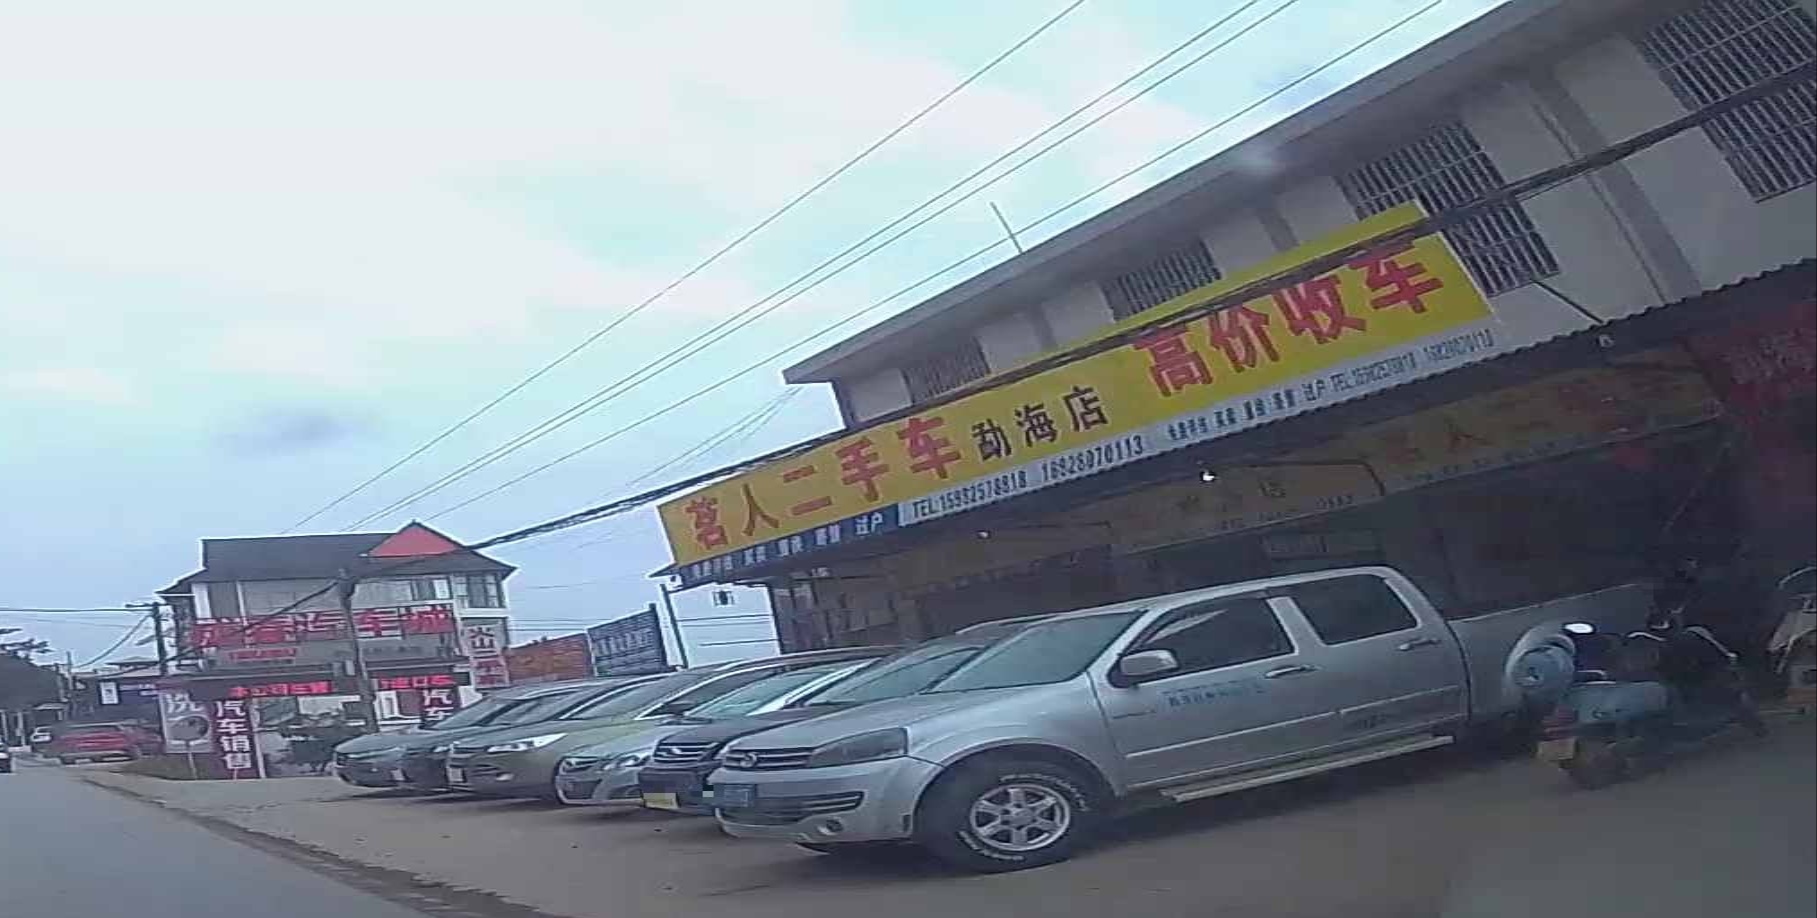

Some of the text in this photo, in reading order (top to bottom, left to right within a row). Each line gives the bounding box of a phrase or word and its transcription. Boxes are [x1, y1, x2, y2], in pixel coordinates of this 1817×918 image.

[972, 384, 1108, 462] 勐海店
[1132, 235, 1444, 397] 高价收车
[216, 701, 252, 769] 汽车销售
